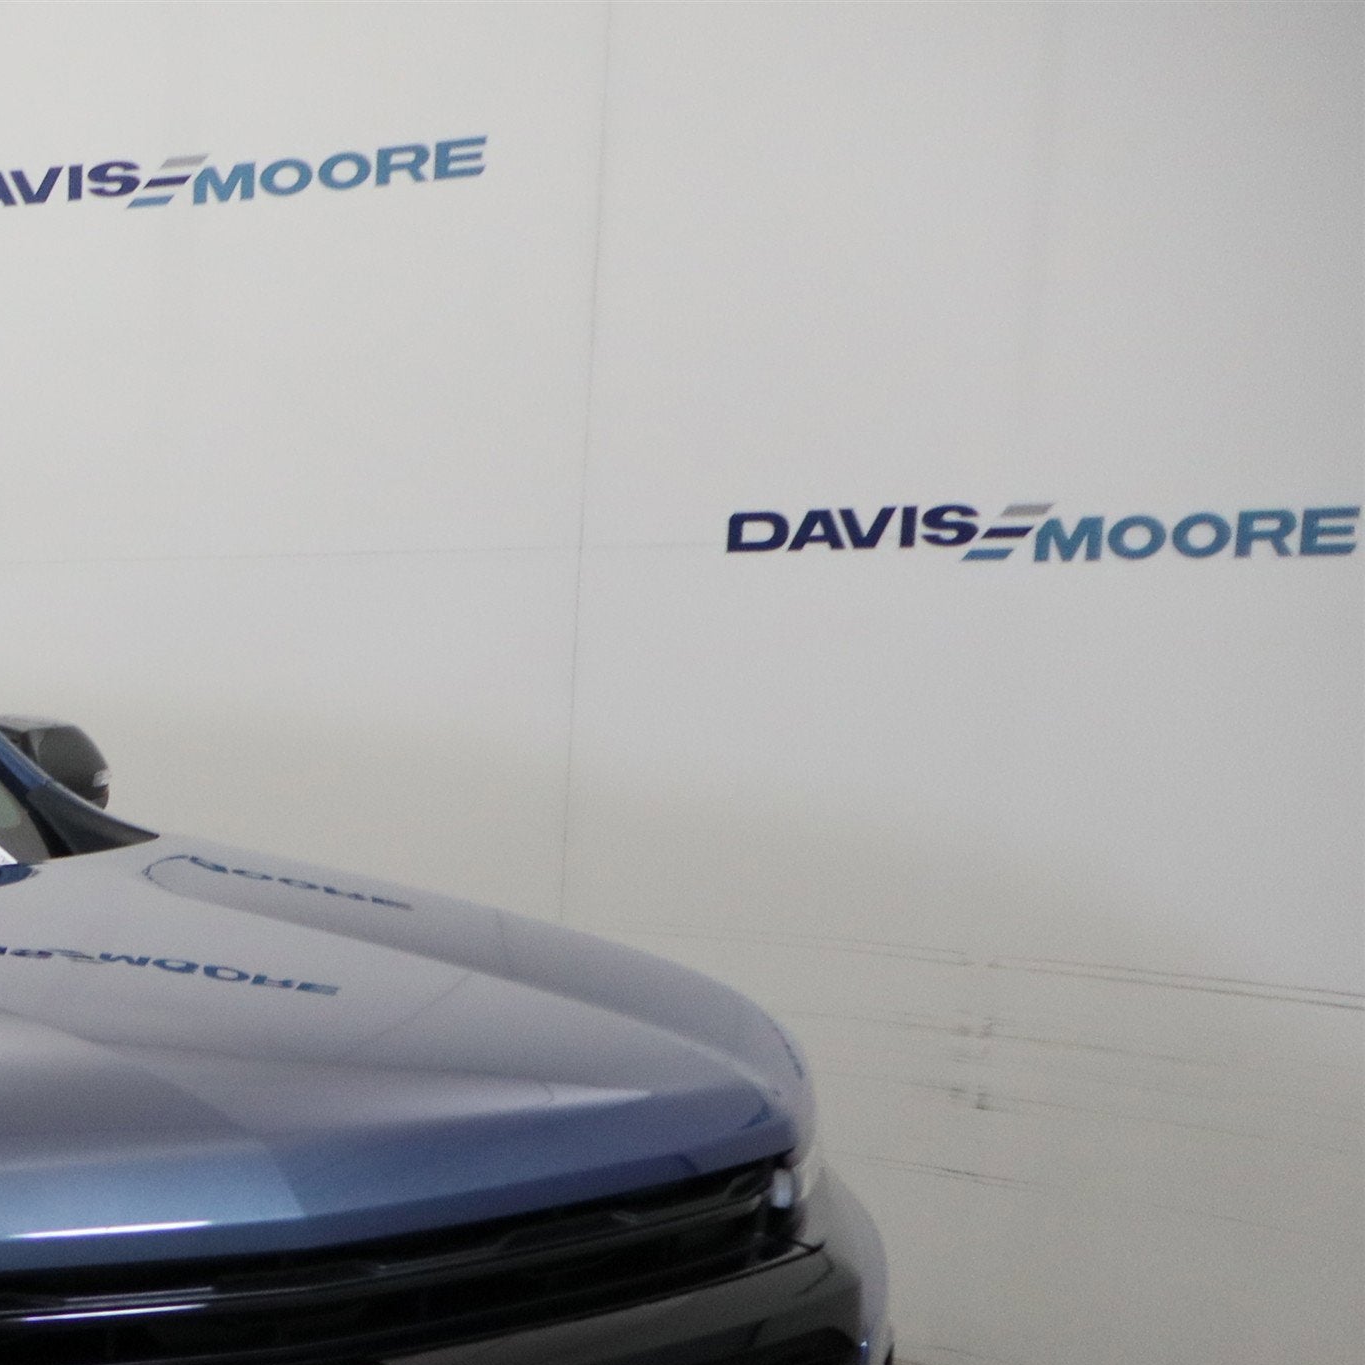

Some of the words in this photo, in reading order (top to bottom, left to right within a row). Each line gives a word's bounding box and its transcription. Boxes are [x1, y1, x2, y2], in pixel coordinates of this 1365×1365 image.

[192, 135, 488, 206] MOORE
[725, 502, 980, 554] DAVIS
[1032, 504, 1362, 564] MOORE
